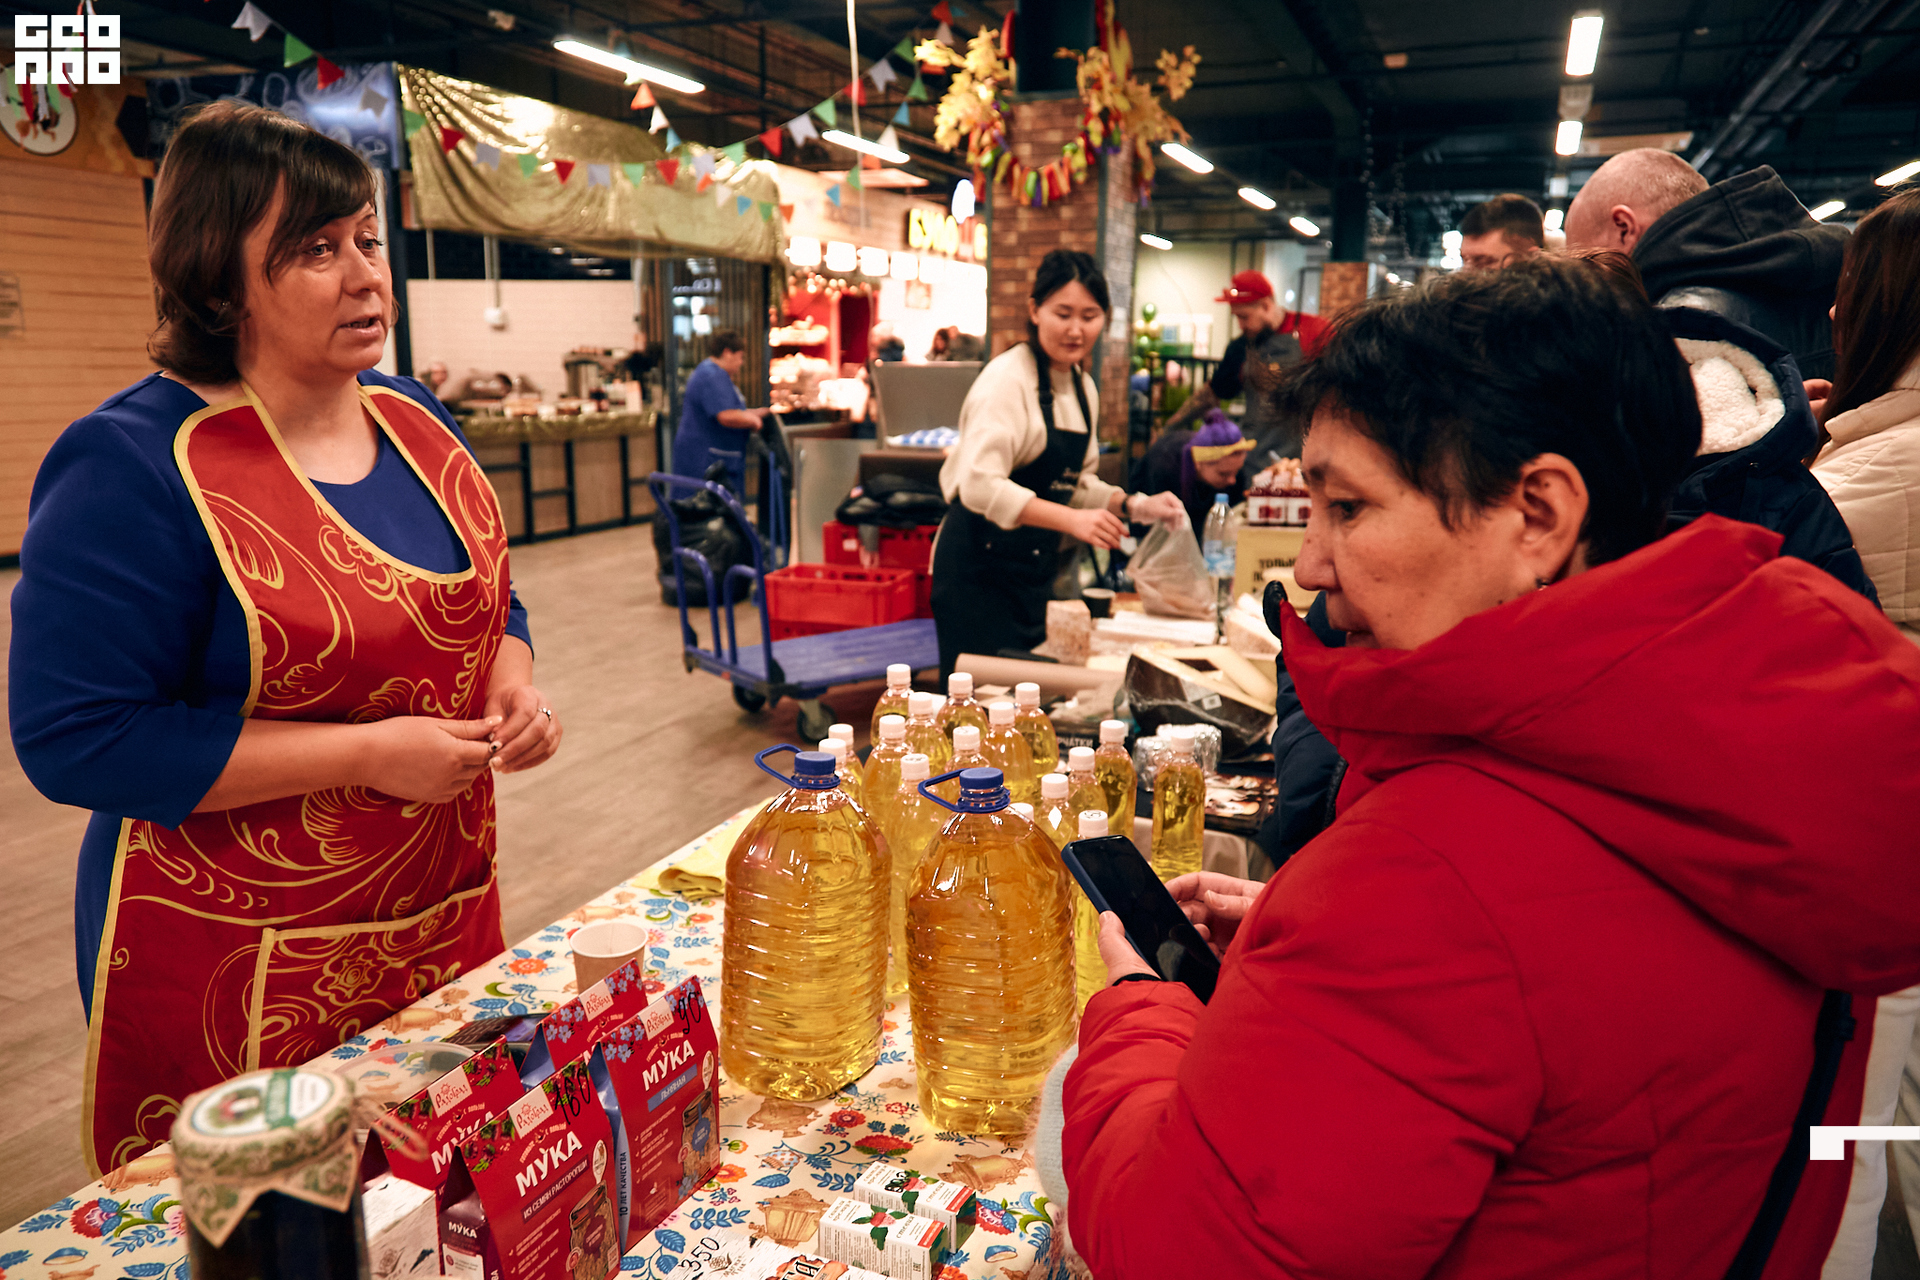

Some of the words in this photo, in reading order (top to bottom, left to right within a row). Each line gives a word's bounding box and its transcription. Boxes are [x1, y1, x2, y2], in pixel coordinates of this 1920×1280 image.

[642, 1040, 695, 1091] МУКА
[555, 1068, 591, 1125] 160
[515, 1131, 582, 1197] МУКА
[532, 1190, 552, 1212] СЕМЯН
[551, 1159, 588, 1196] РАСТОРОПШИ
[620, 1151, 628, 1190] КАЧЕСТВА
[448, 1221, 478, 1239] МУКА
[619, 1206, 628, 1216] 10
[678, 1237, 720, 1272] 350
